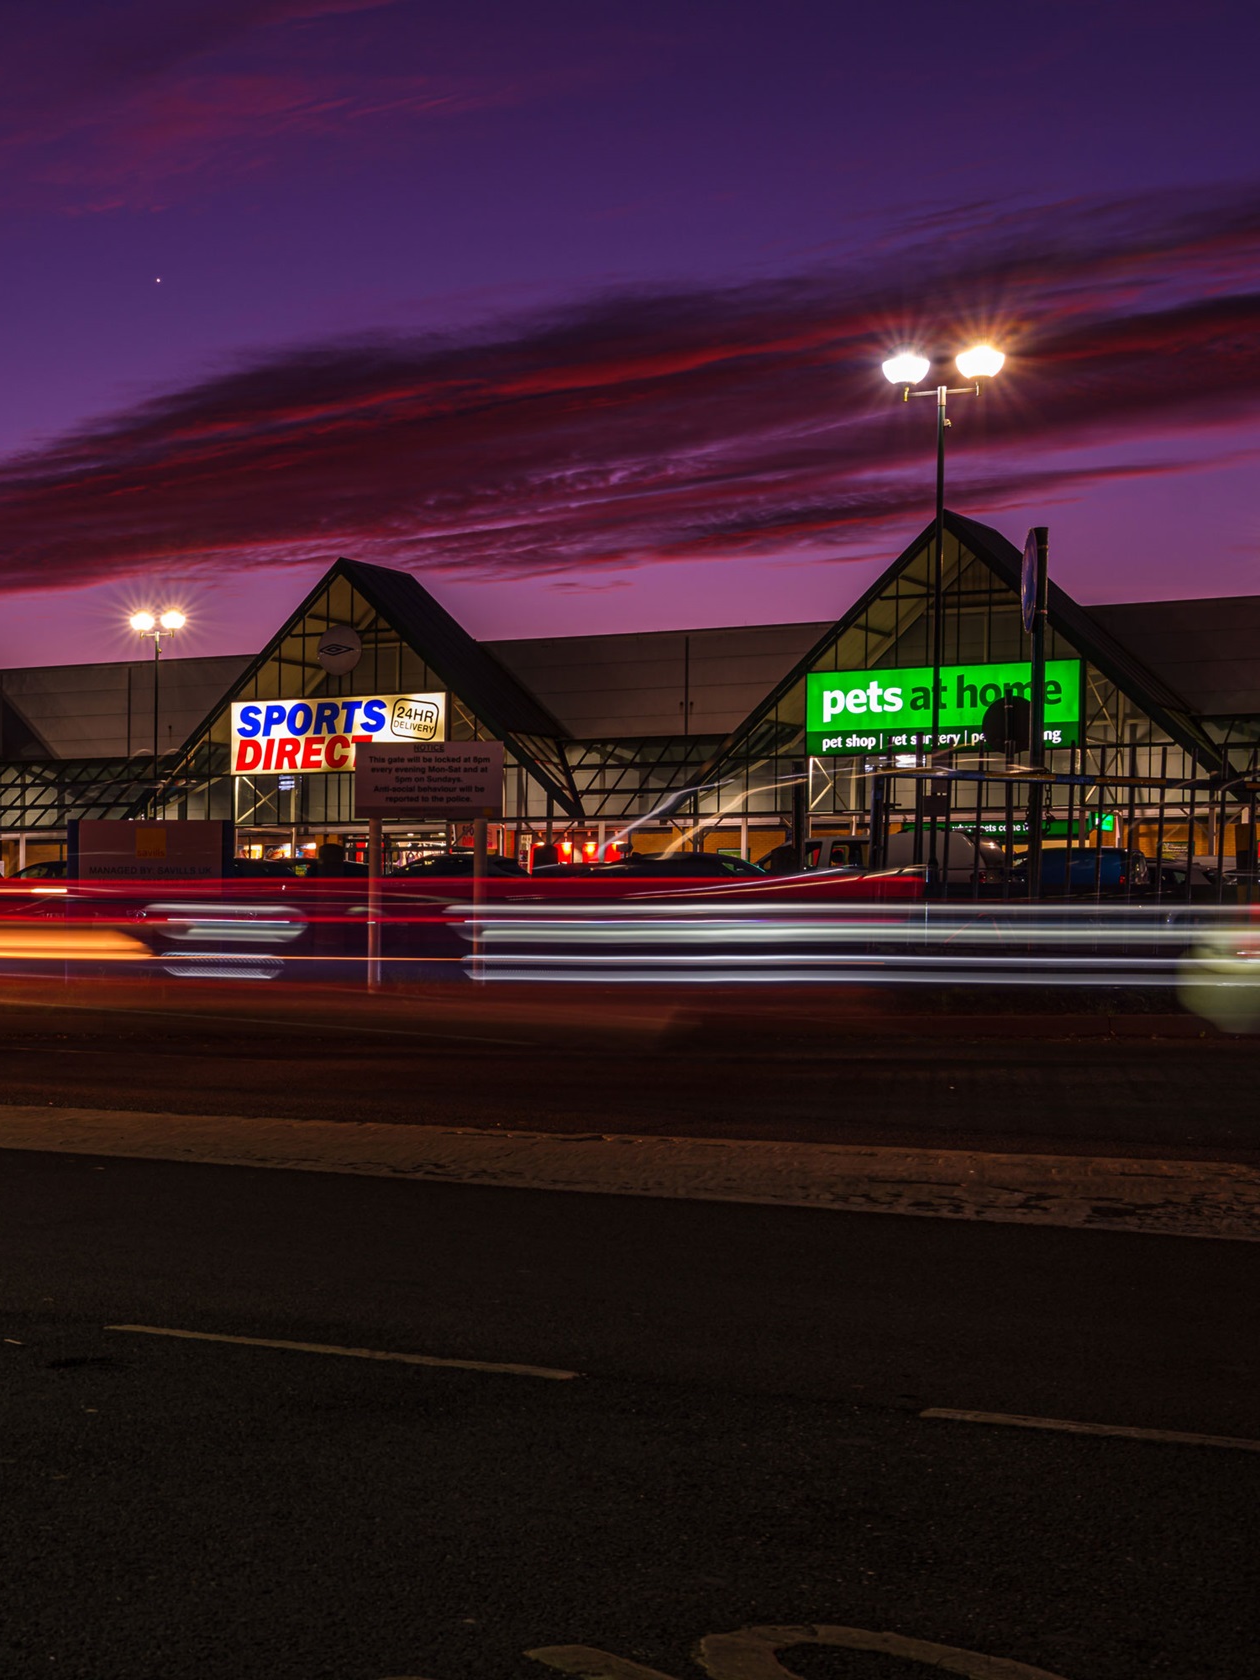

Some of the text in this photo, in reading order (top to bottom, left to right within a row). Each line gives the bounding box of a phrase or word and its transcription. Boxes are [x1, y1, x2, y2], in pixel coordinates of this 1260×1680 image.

[822, 680, 903, 723] pets
[910, 678, 947, 710] at
[237, 699, 387, 738] SPORTS
[397, 706, 434, 724] 24HR
[393, 720, 434, 734] DELIVERY
[822, 736, 843, 751] pet
[845, 734, 876, 750] shop
[414, 744, 444, 752] NOTICE
[388, 756, 405, 765] gate
[473, 756, 490, 765] 8pm
[395, 766, 425, 774] evening
[395, 776, 412, 784] 5pm
[426, 776, 463, 784] Sundays.
[374, 785, 485, 793] Anti-social behaviour will be
[385, 796, 419, 804] reported
[446, 796, 472, 804] police.
[137, 848, 165, 857] savills
[89, 866, 137, 875] MANAGED
[157, 866, 196, 875] SAVILLS
[198, 866, 212, 875] UK
